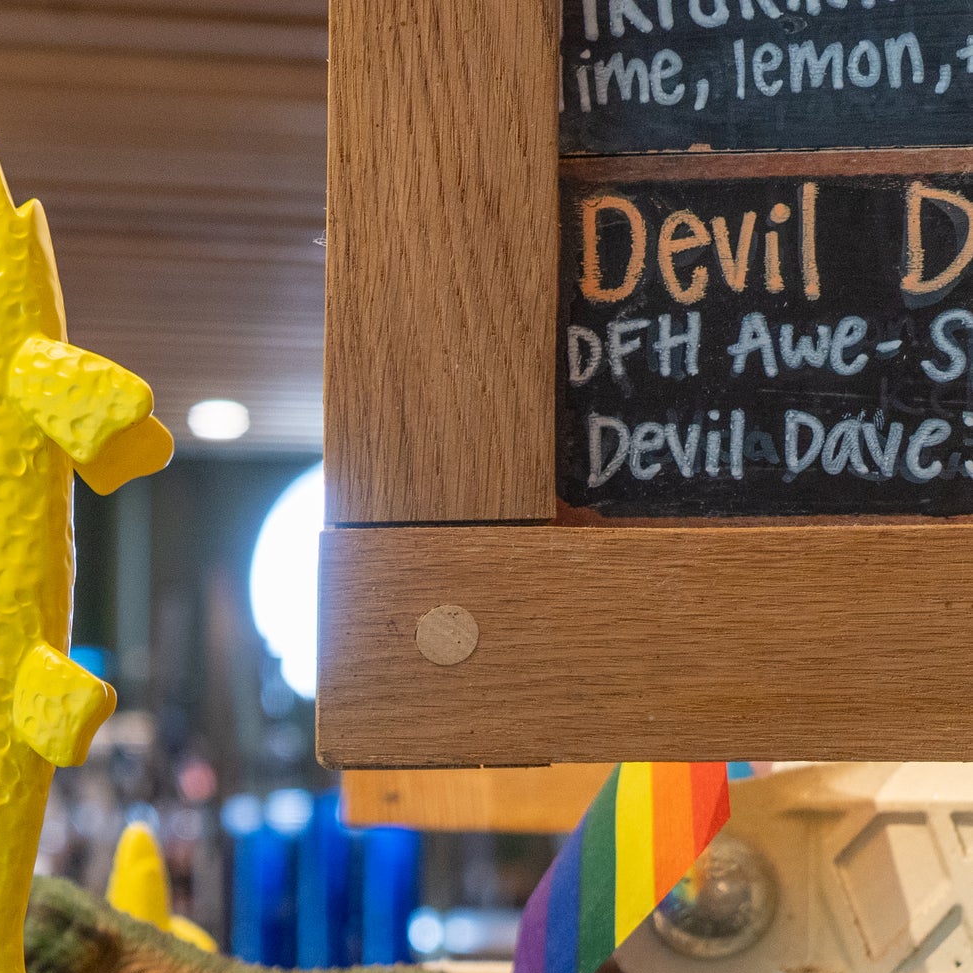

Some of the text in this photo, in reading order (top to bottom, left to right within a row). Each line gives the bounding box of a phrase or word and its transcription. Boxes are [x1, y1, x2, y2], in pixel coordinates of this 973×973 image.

[733, 32, 952, 100] lemon,
[578, 182, 821, 303] Devil
[567, 310, 701, 386] DFH
[587, 408, 746, 489] Devil
